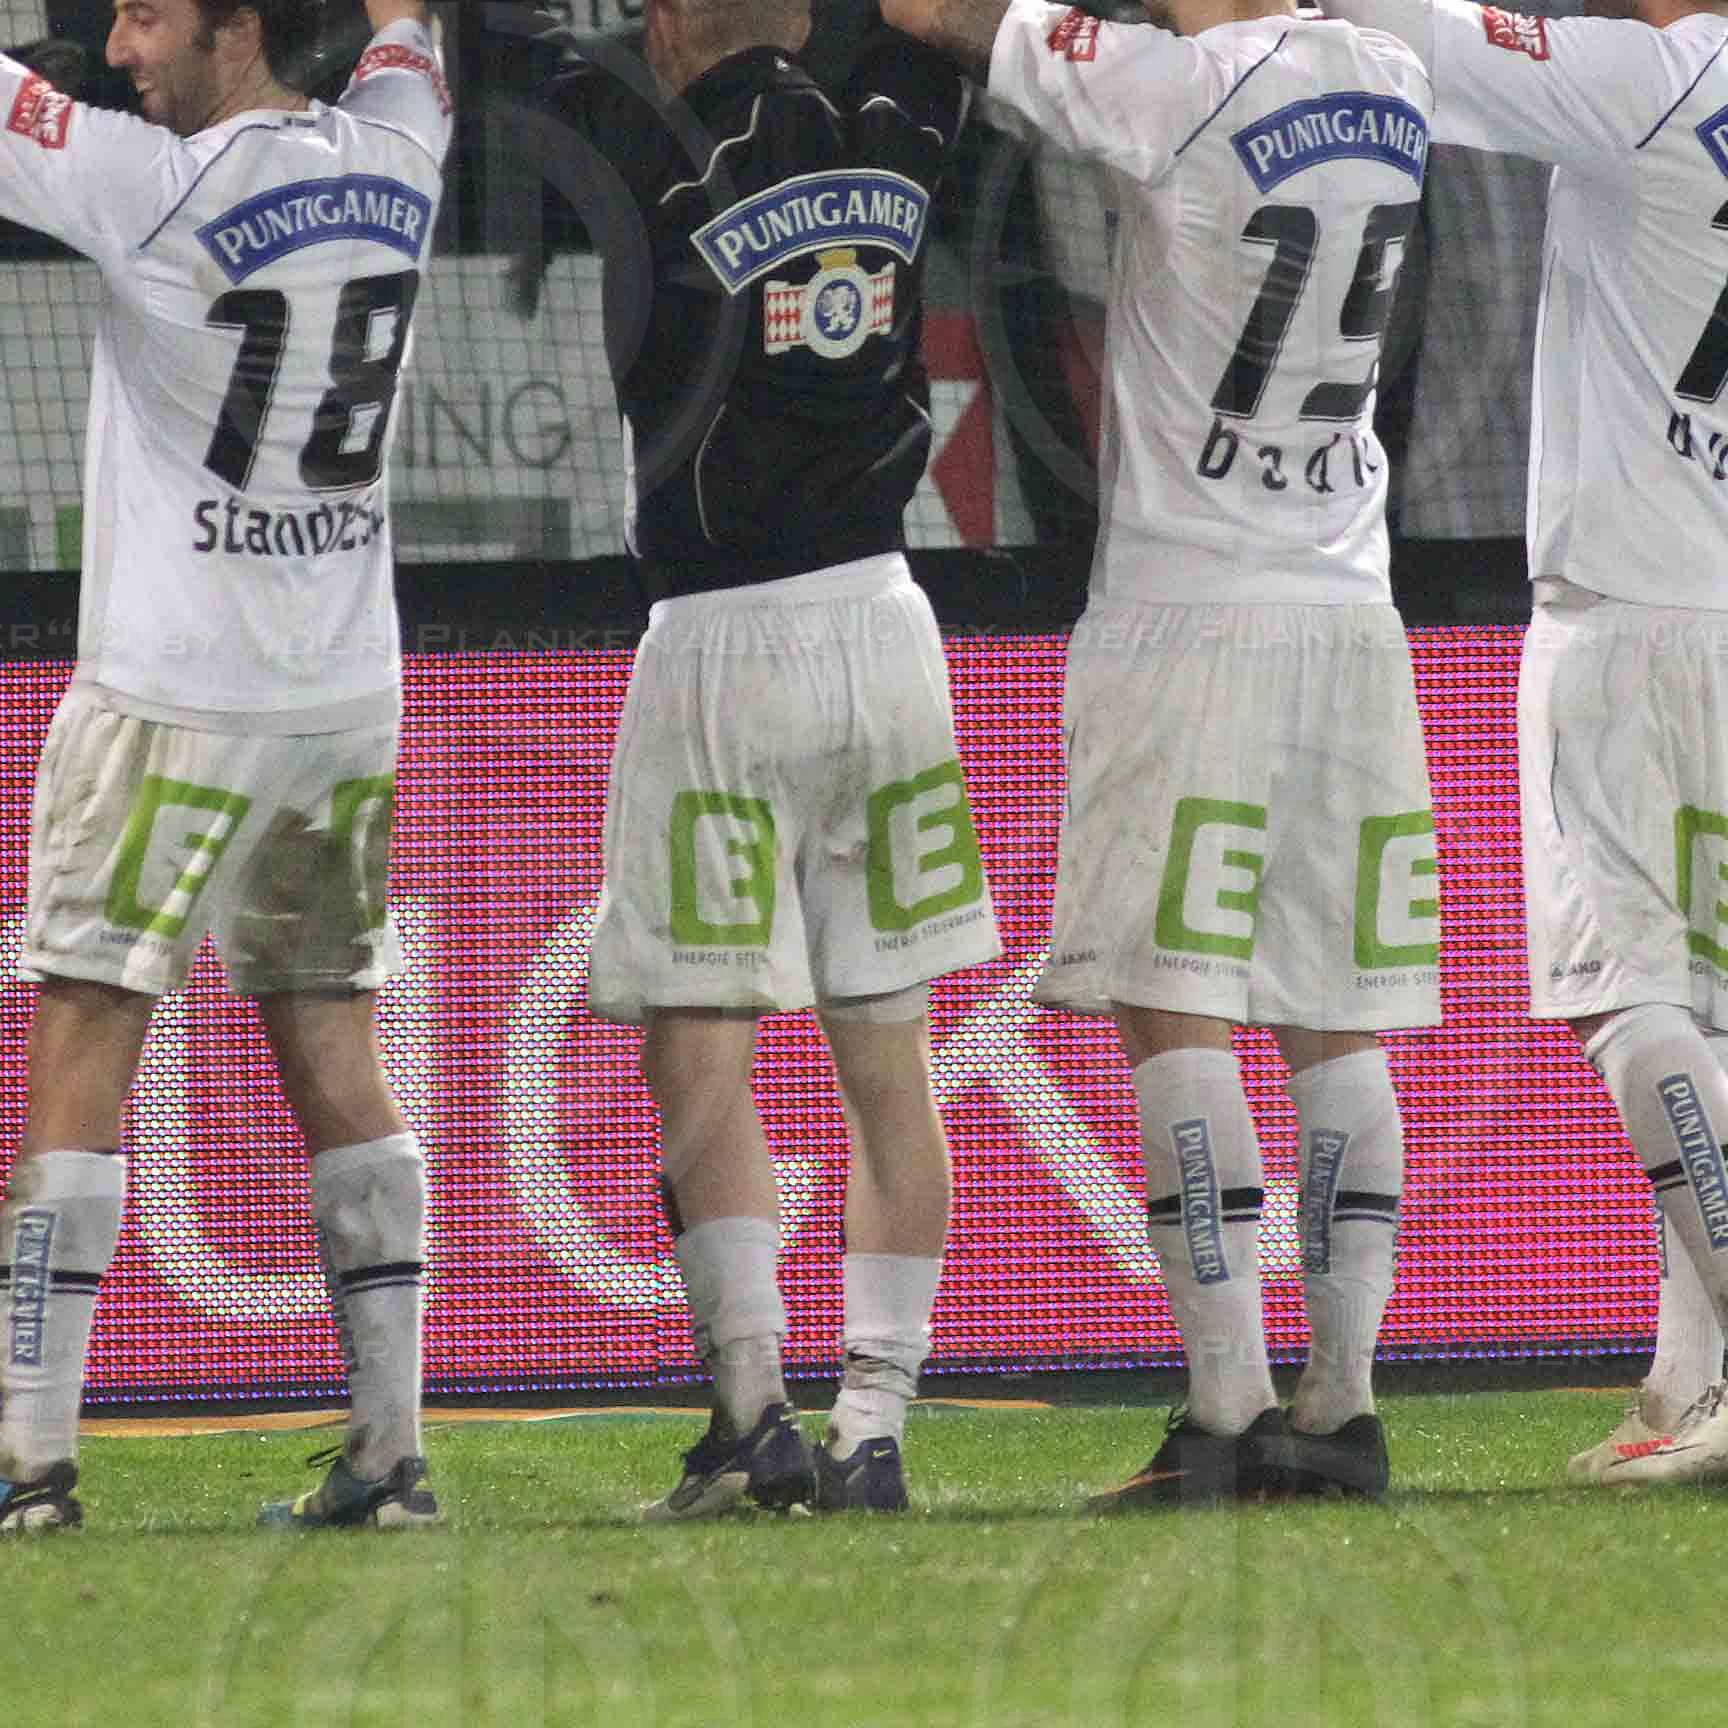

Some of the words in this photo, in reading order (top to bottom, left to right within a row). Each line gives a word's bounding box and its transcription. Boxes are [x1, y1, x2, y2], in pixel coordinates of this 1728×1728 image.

[215, 188, 422, 264] PUNTIGAMER
[713, 189, 920, 269] PUNTIGAMER
[202, 268, 420, 491] 18
[1176, 1126, 1223, 1279] PUNTIGAMER
